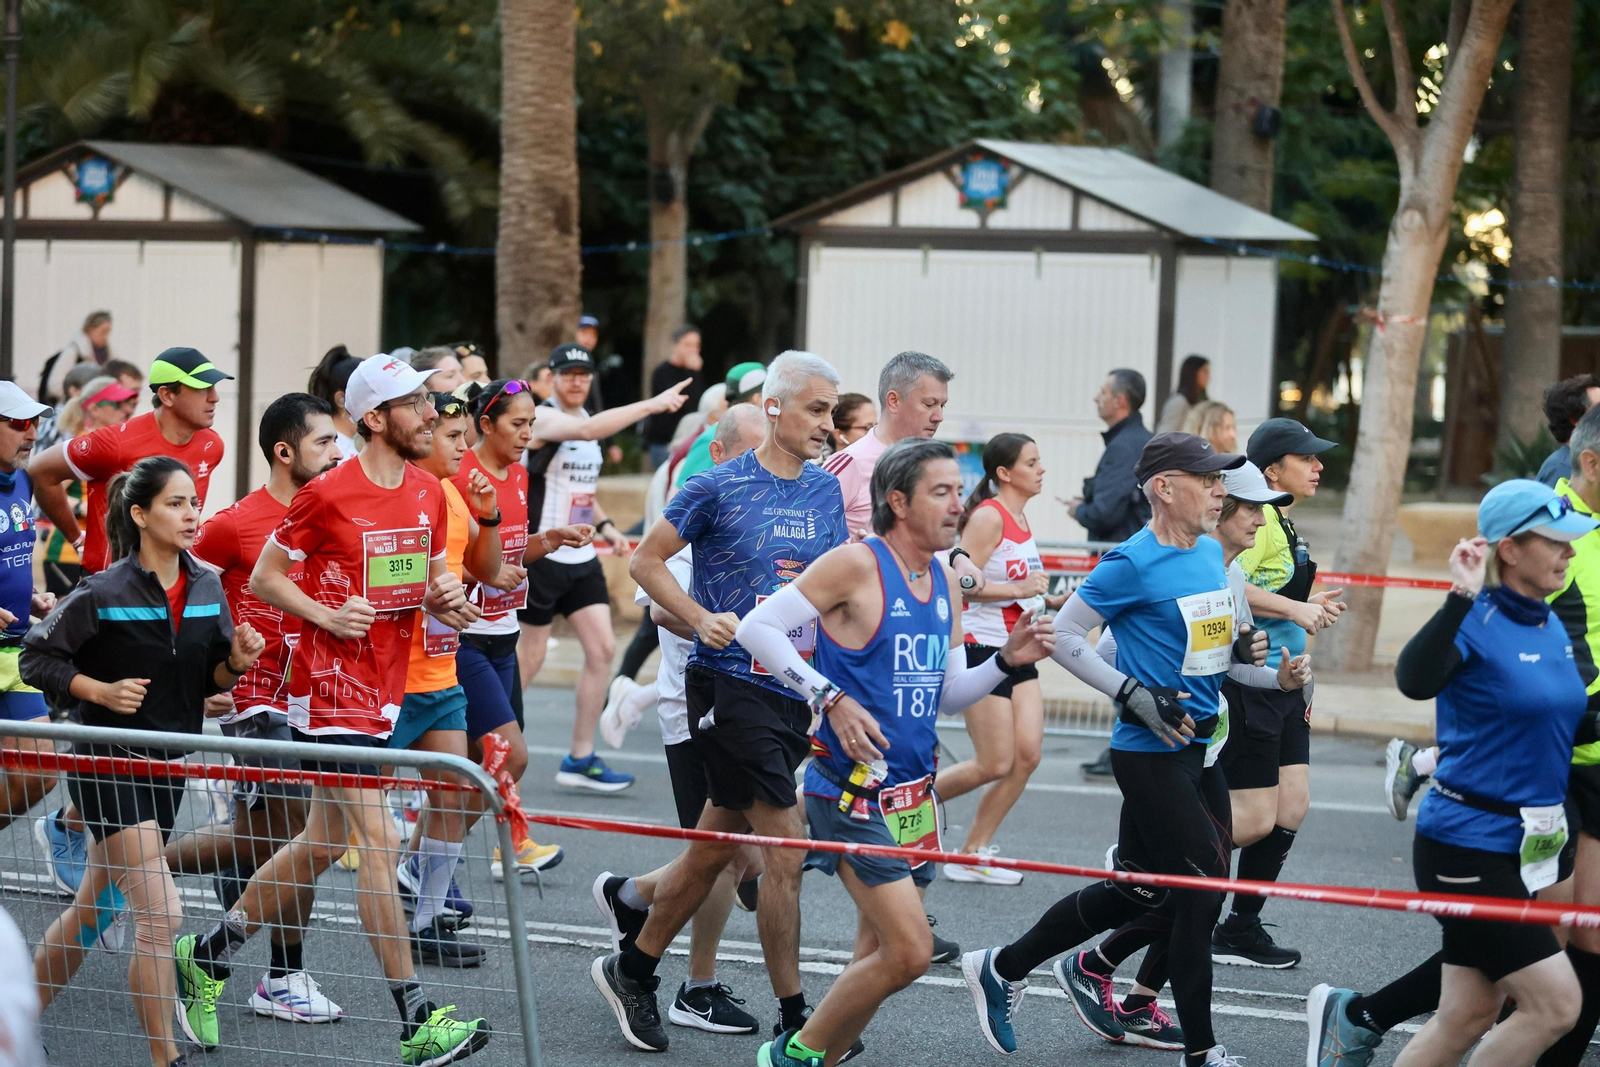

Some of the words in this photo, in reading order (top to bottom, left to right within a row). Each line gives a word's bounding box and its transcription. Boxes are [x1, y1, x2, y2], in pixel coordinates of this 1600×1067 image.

[773, 508, 805, 518] GENERALI
[773, 523, 806, 540] MÁLAGA
[374, 544, 394, 554] MÁLAGA
[504, 537, 524, 549] MÁLAGA
[389, 558, 413, 573] 3315
[1202, 620, 1227, 637] 12934
[1133, 886, 1155, 899] ACE
